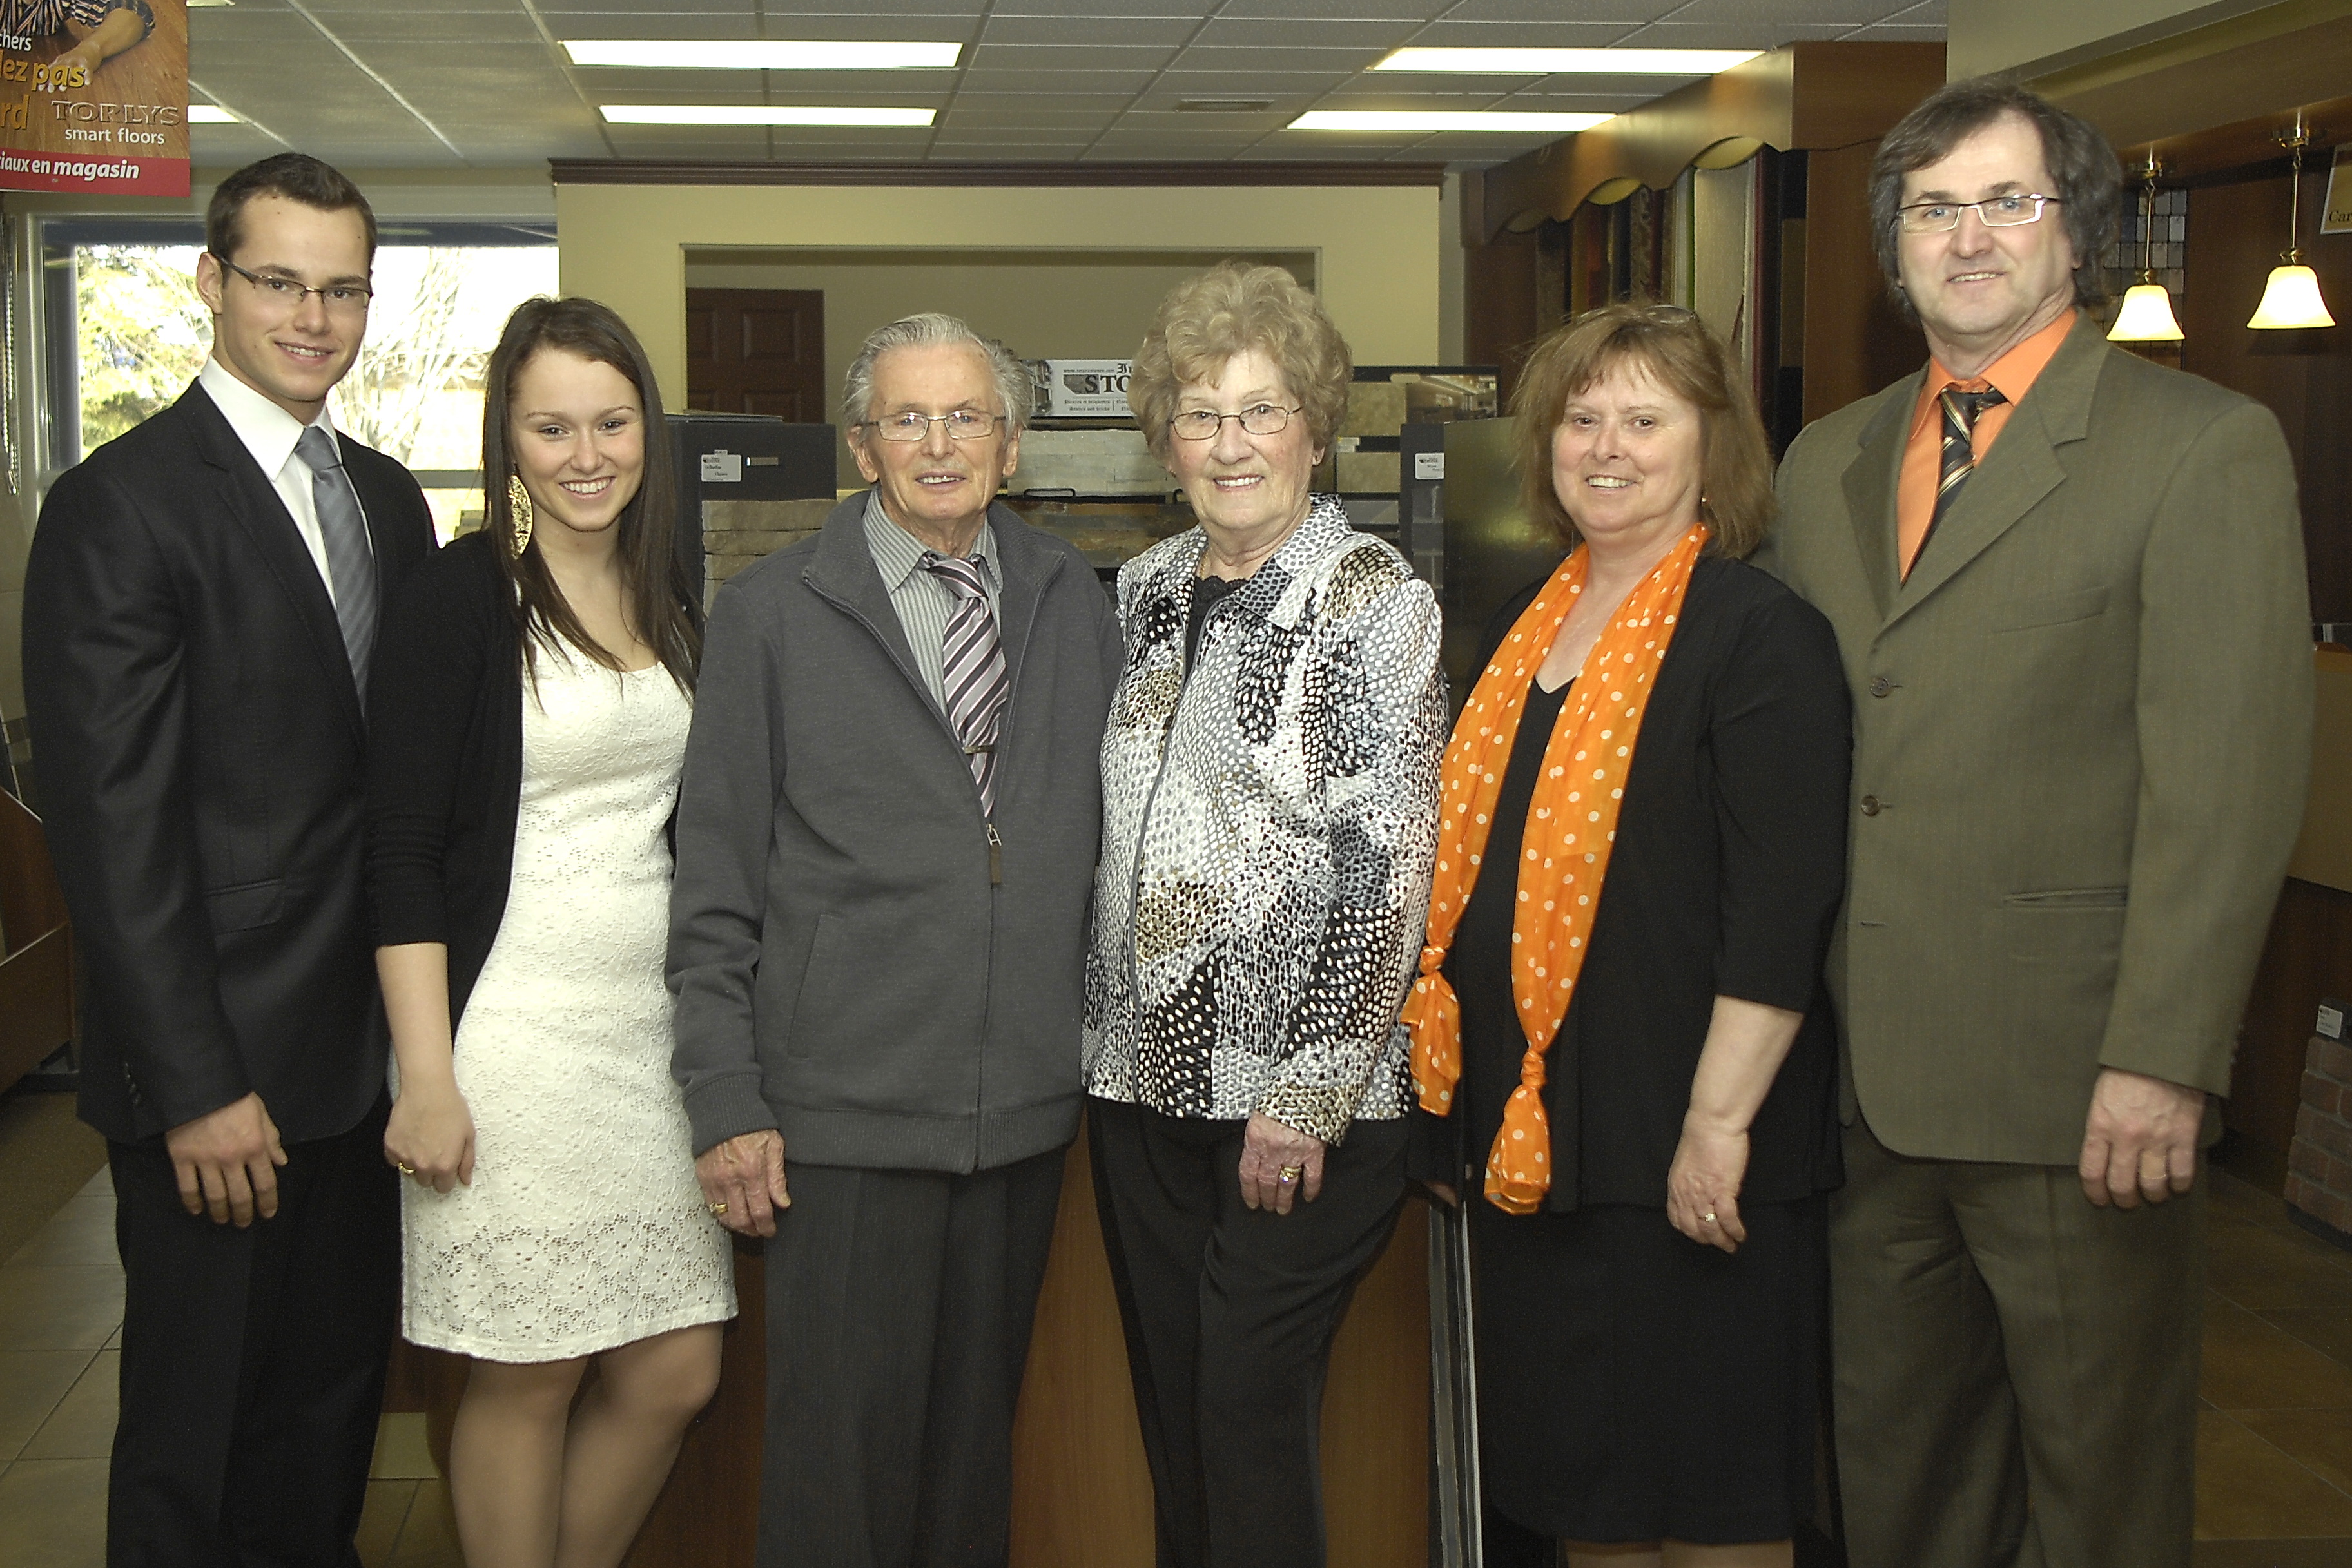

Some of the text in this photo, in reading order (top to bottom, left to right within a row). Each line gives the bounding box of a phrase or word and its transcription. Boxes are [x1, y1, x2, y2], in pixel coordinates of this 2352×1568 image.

[32, 63, 86, 91] pas
[51, 100, 181, 126] TORLYS
[65, 128, 165, 144] smart floors
[32, 159, 50, 175] en
[53, 159, 139, 181] magasin
